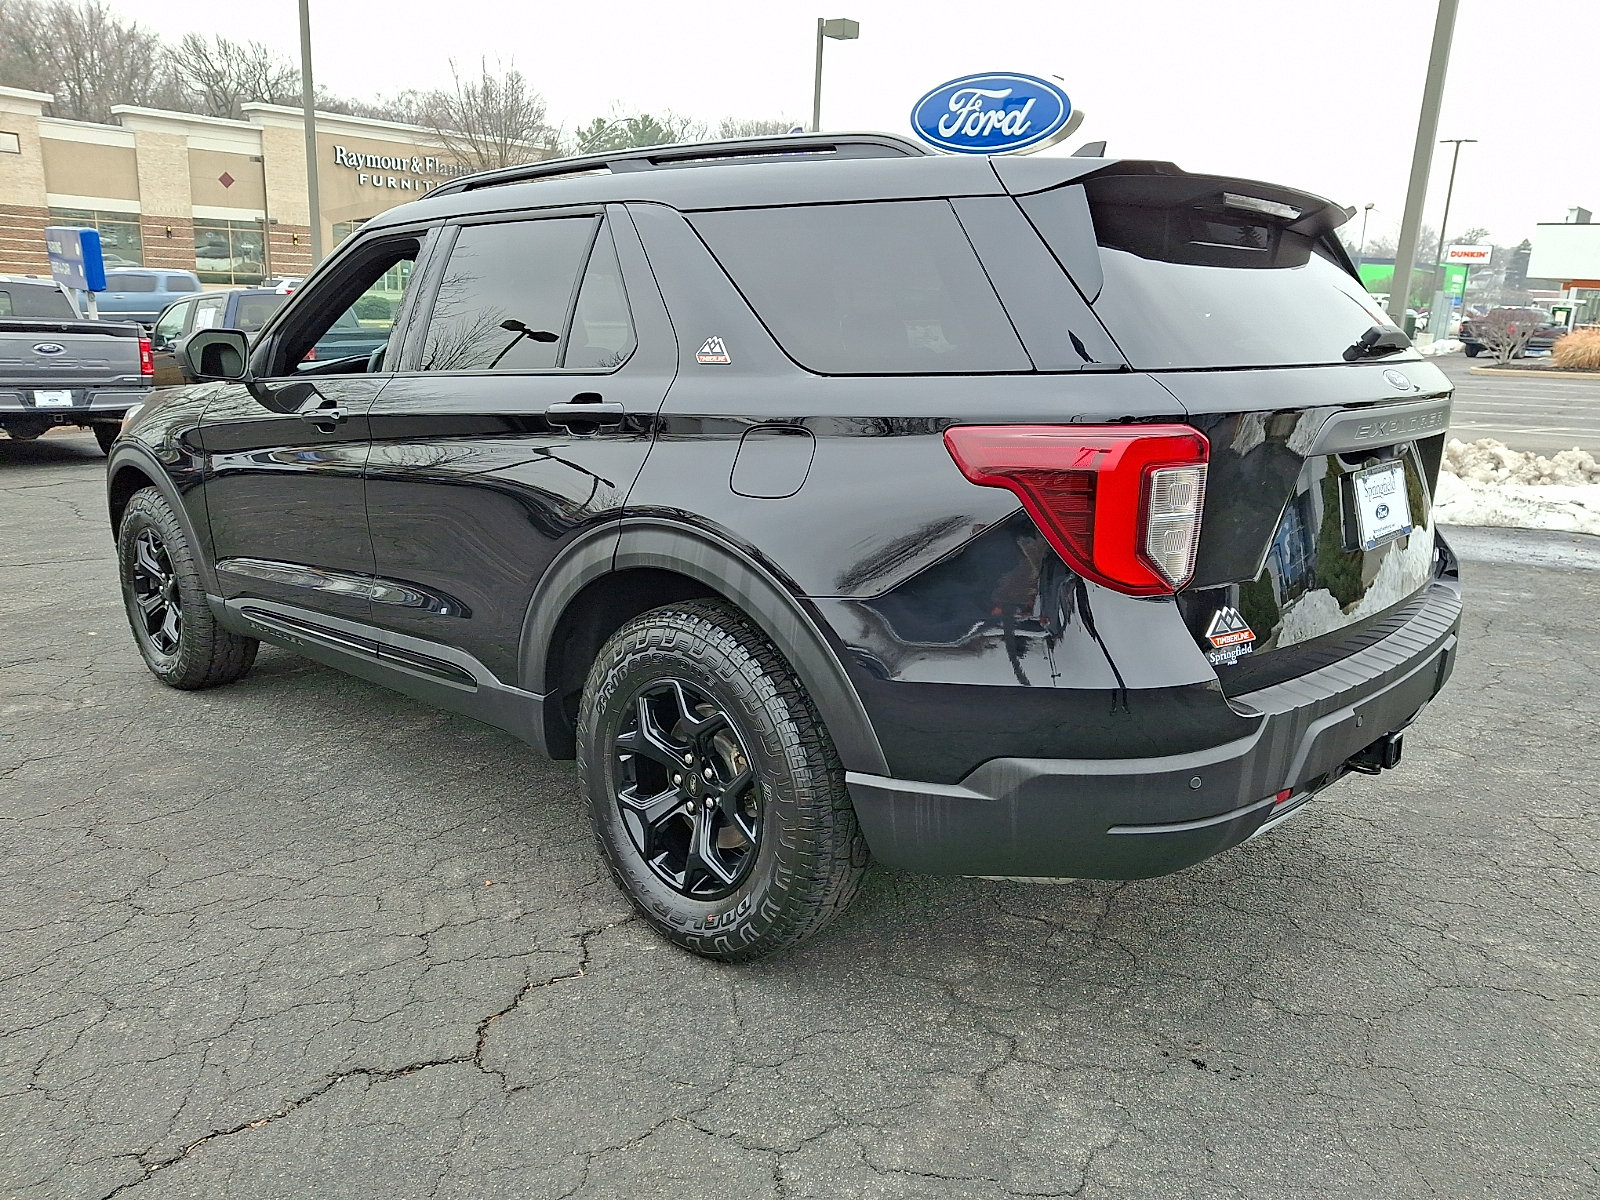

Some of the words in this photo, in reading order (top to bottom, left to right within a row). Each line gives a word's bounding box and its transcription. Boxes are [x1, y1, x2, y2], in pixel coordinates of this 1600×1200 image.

[938, 88, 1037, 138] Ford
[334, 145, 409, 171] Raymour
[410, 156, 423, 175] &
[1354, 412, 1443, 440] EXPLORER
[1215, 631, 1251, 646] TIMBERLINE
[1209, 642, 1253, 665] Springfield
